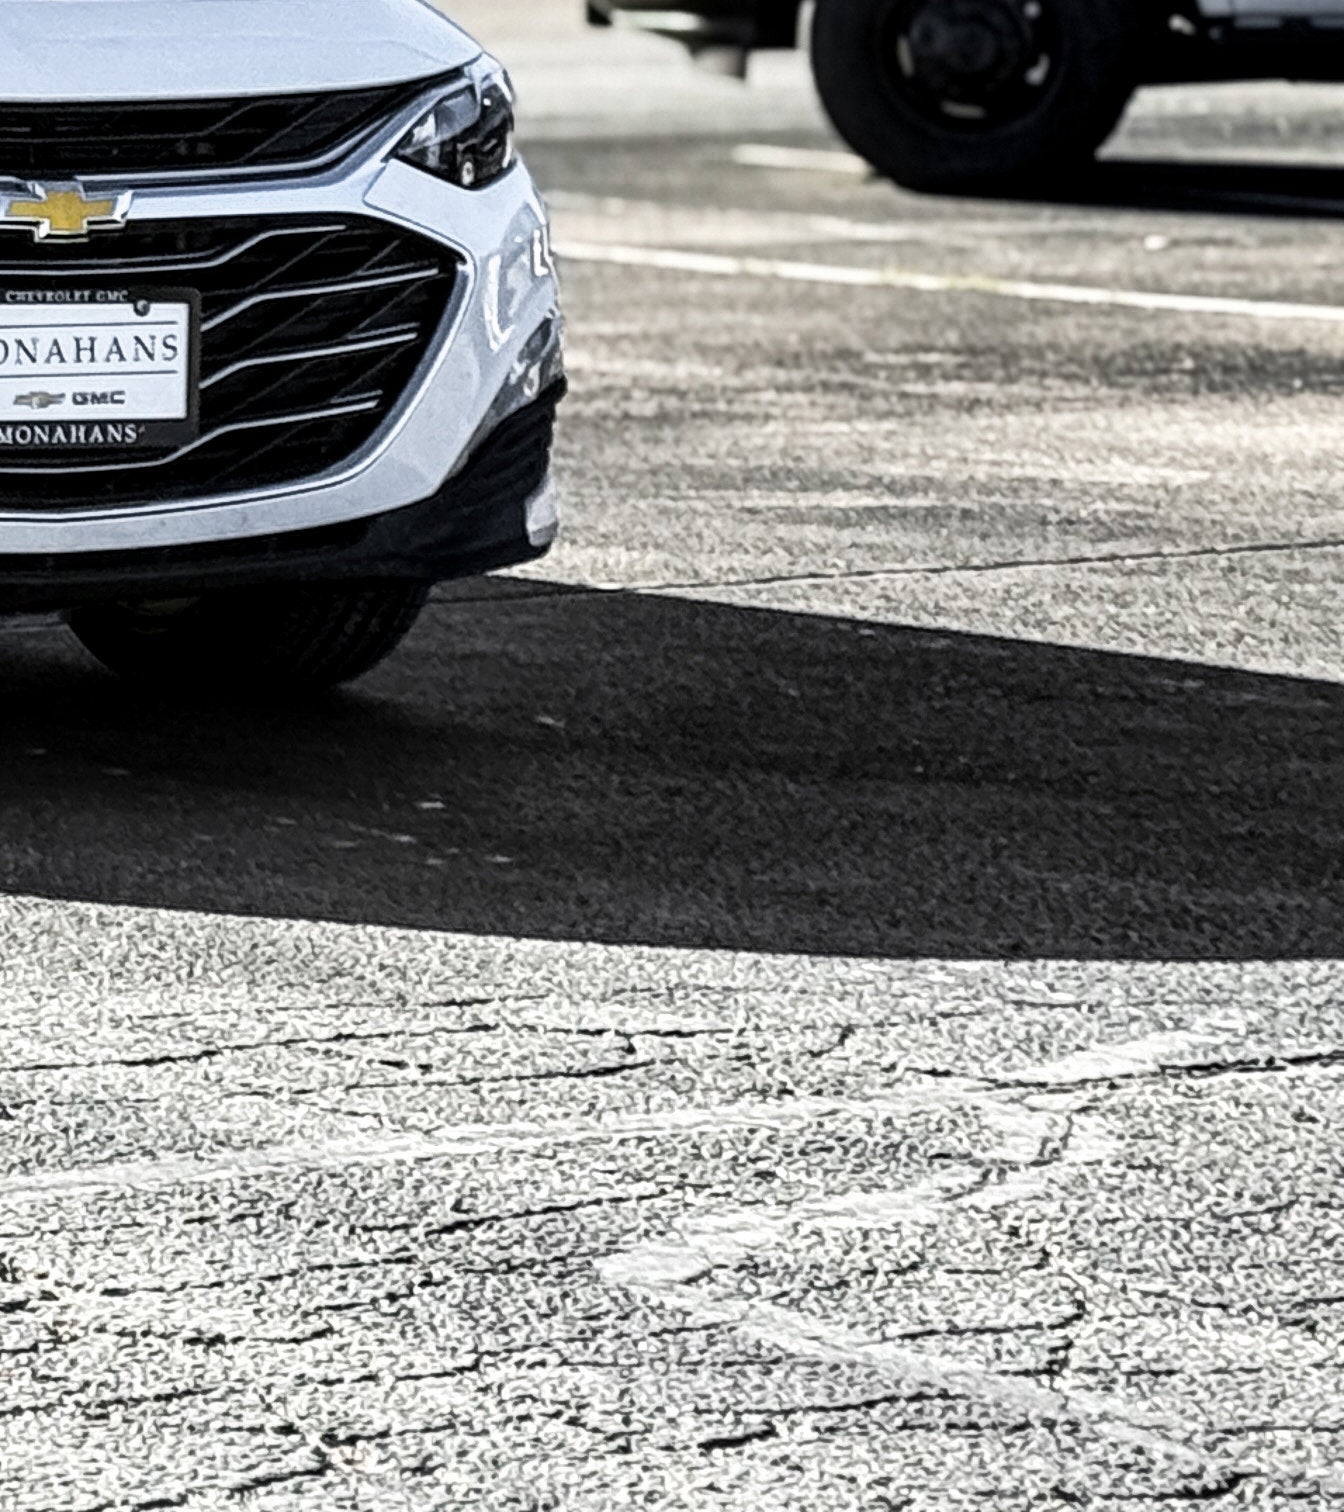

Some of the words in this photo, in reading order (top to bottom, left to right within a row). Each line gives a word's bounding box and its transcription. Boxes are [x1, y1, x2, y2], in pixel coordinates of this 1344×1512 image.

[5, 289, 90, 302] CHEVROLET
[95, 289, 129, 302] GMC
[72, 390, 126, 406] GMC
